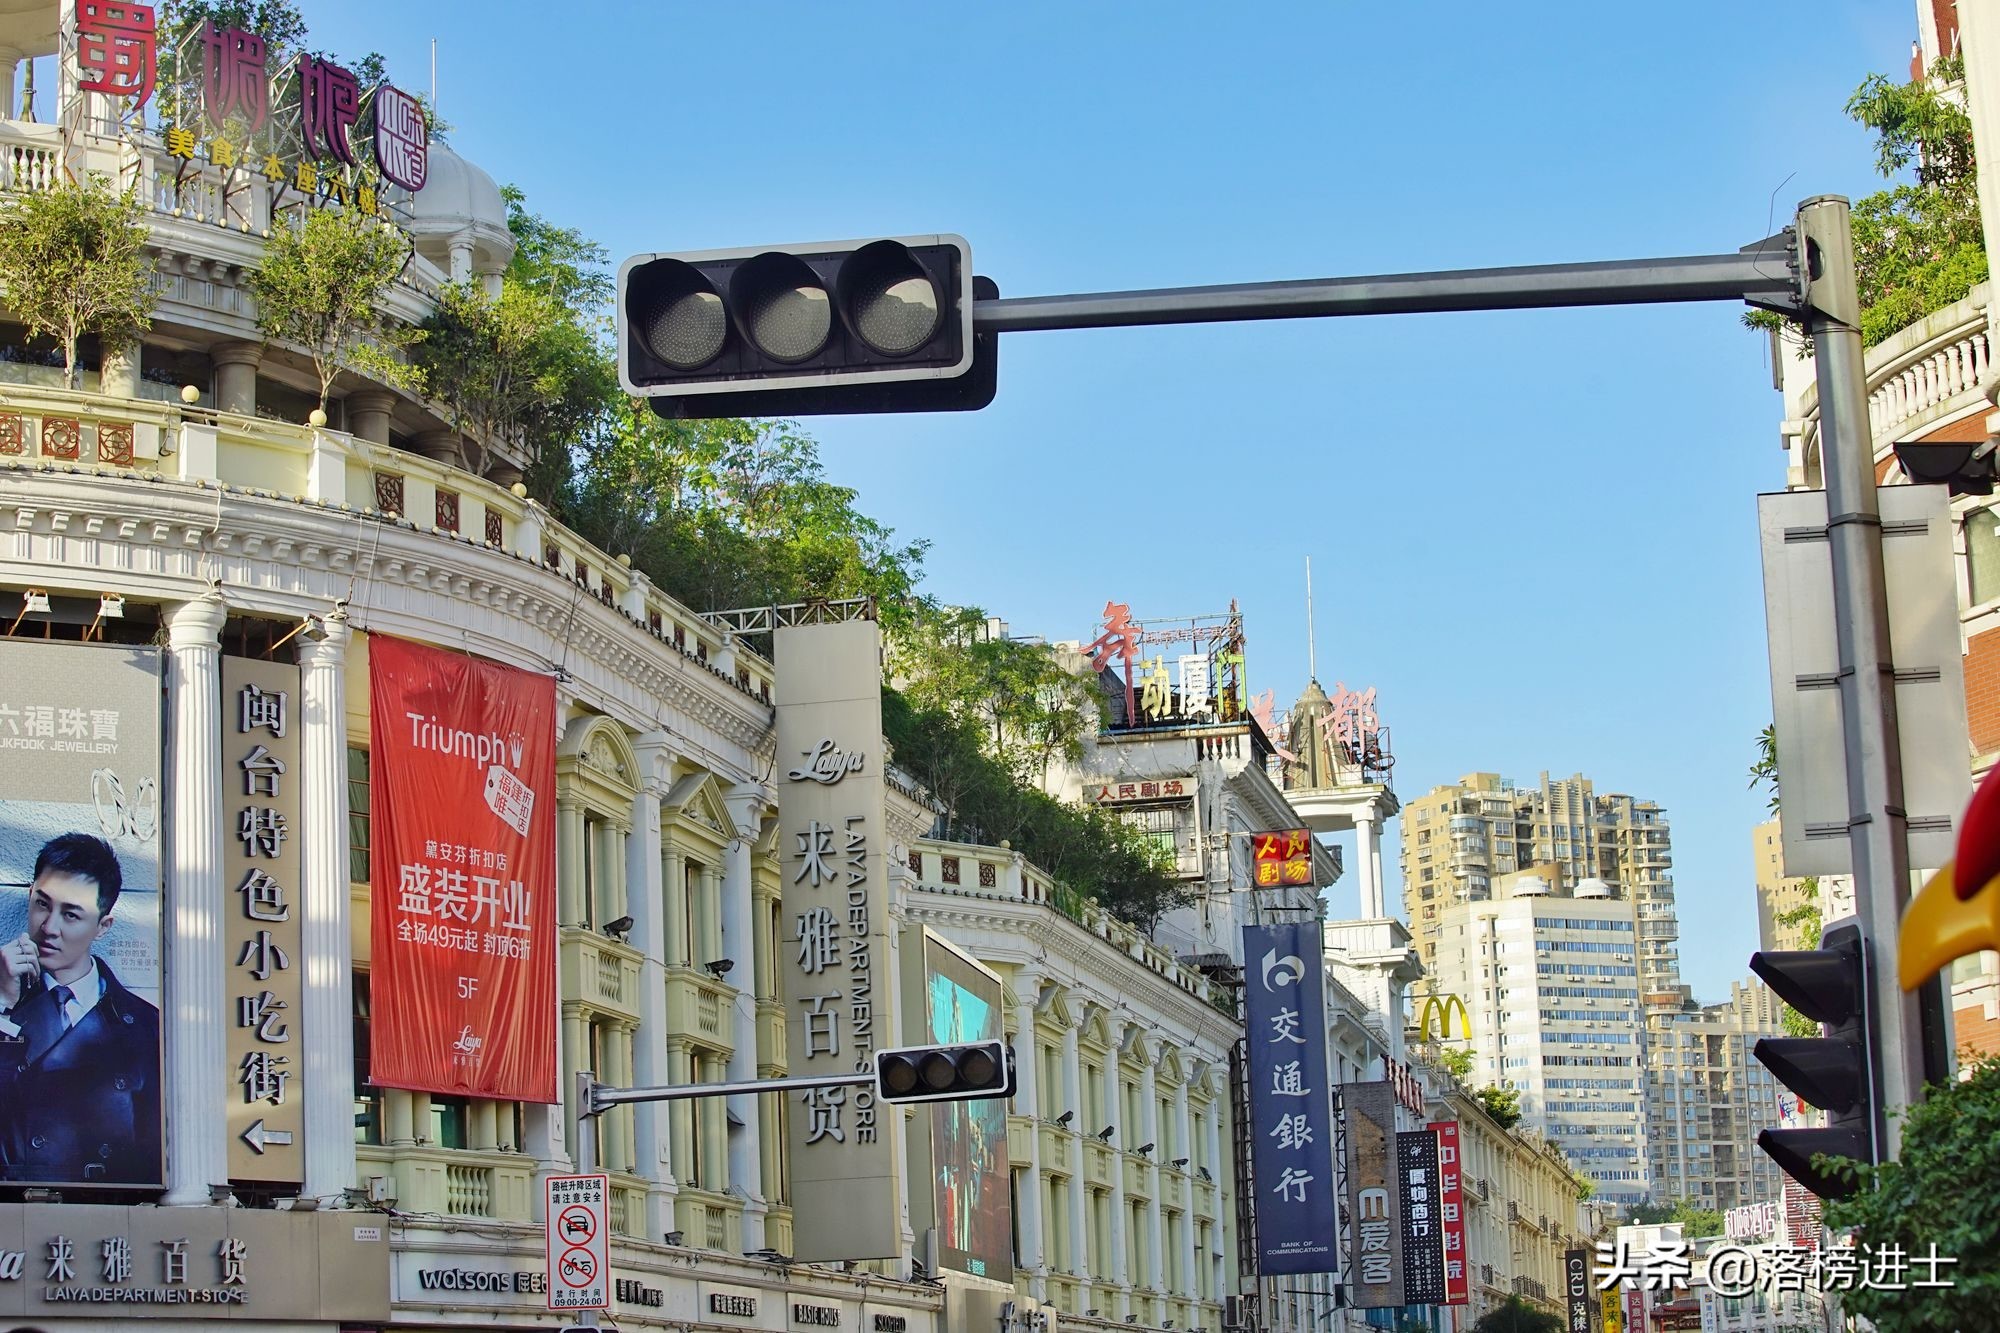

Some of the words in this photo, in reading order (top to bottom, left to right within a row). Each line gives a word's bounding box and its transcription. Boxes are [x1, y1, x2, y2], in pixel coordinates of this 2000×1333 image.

[50, 740, 118, 754] JEWELLERY
[406, 712, 506, 770] Triumph
[788, 736, 865, 786] Laiya
[499, 772, 523, 806] 福建
[1096, 780, 1184, 801] 人民剧场
[494, 791, 519, 817] 唯一
[516, 789, 532, 832] 折扣店
[425, 839, 507, 871] 黛安芬折扣店
[845, 815, 867, 888] LAIYA
[1258, 832, 1305, 859] 人民
[1259, 860, 1308, 884] 剧场
[239, 683, 291, 1106] 闽台特色小吃街
[397, 862, 531, 931] 盛装开业
[397, 918, 478, 953] 全场49元起
[483, 932, 531, 961] 封顶6折
[458, 977, 478, 999] 5F
[793, 820, 847, 1145] 来雅百货
[1269, 1006, 1314, 1203] 交通銀行
[552, 1179, 600, 1192] 路桩升降区域
[552, 1192, 601, 1205] 请注意安全
[46, 1235, 248, 1285] 来雅百货
[1267, 1247, 1328, 1255] COMMUNICATIONS
[419, 1268, 511, 1292] watsons
[1570, 1258, 1584, 1297] CRD
[45, 1287, 88, 1302] LAIYA
[556, 1289, 601, 1298] 禁行时间
[796, 1304, 818, 1324] BASIC
